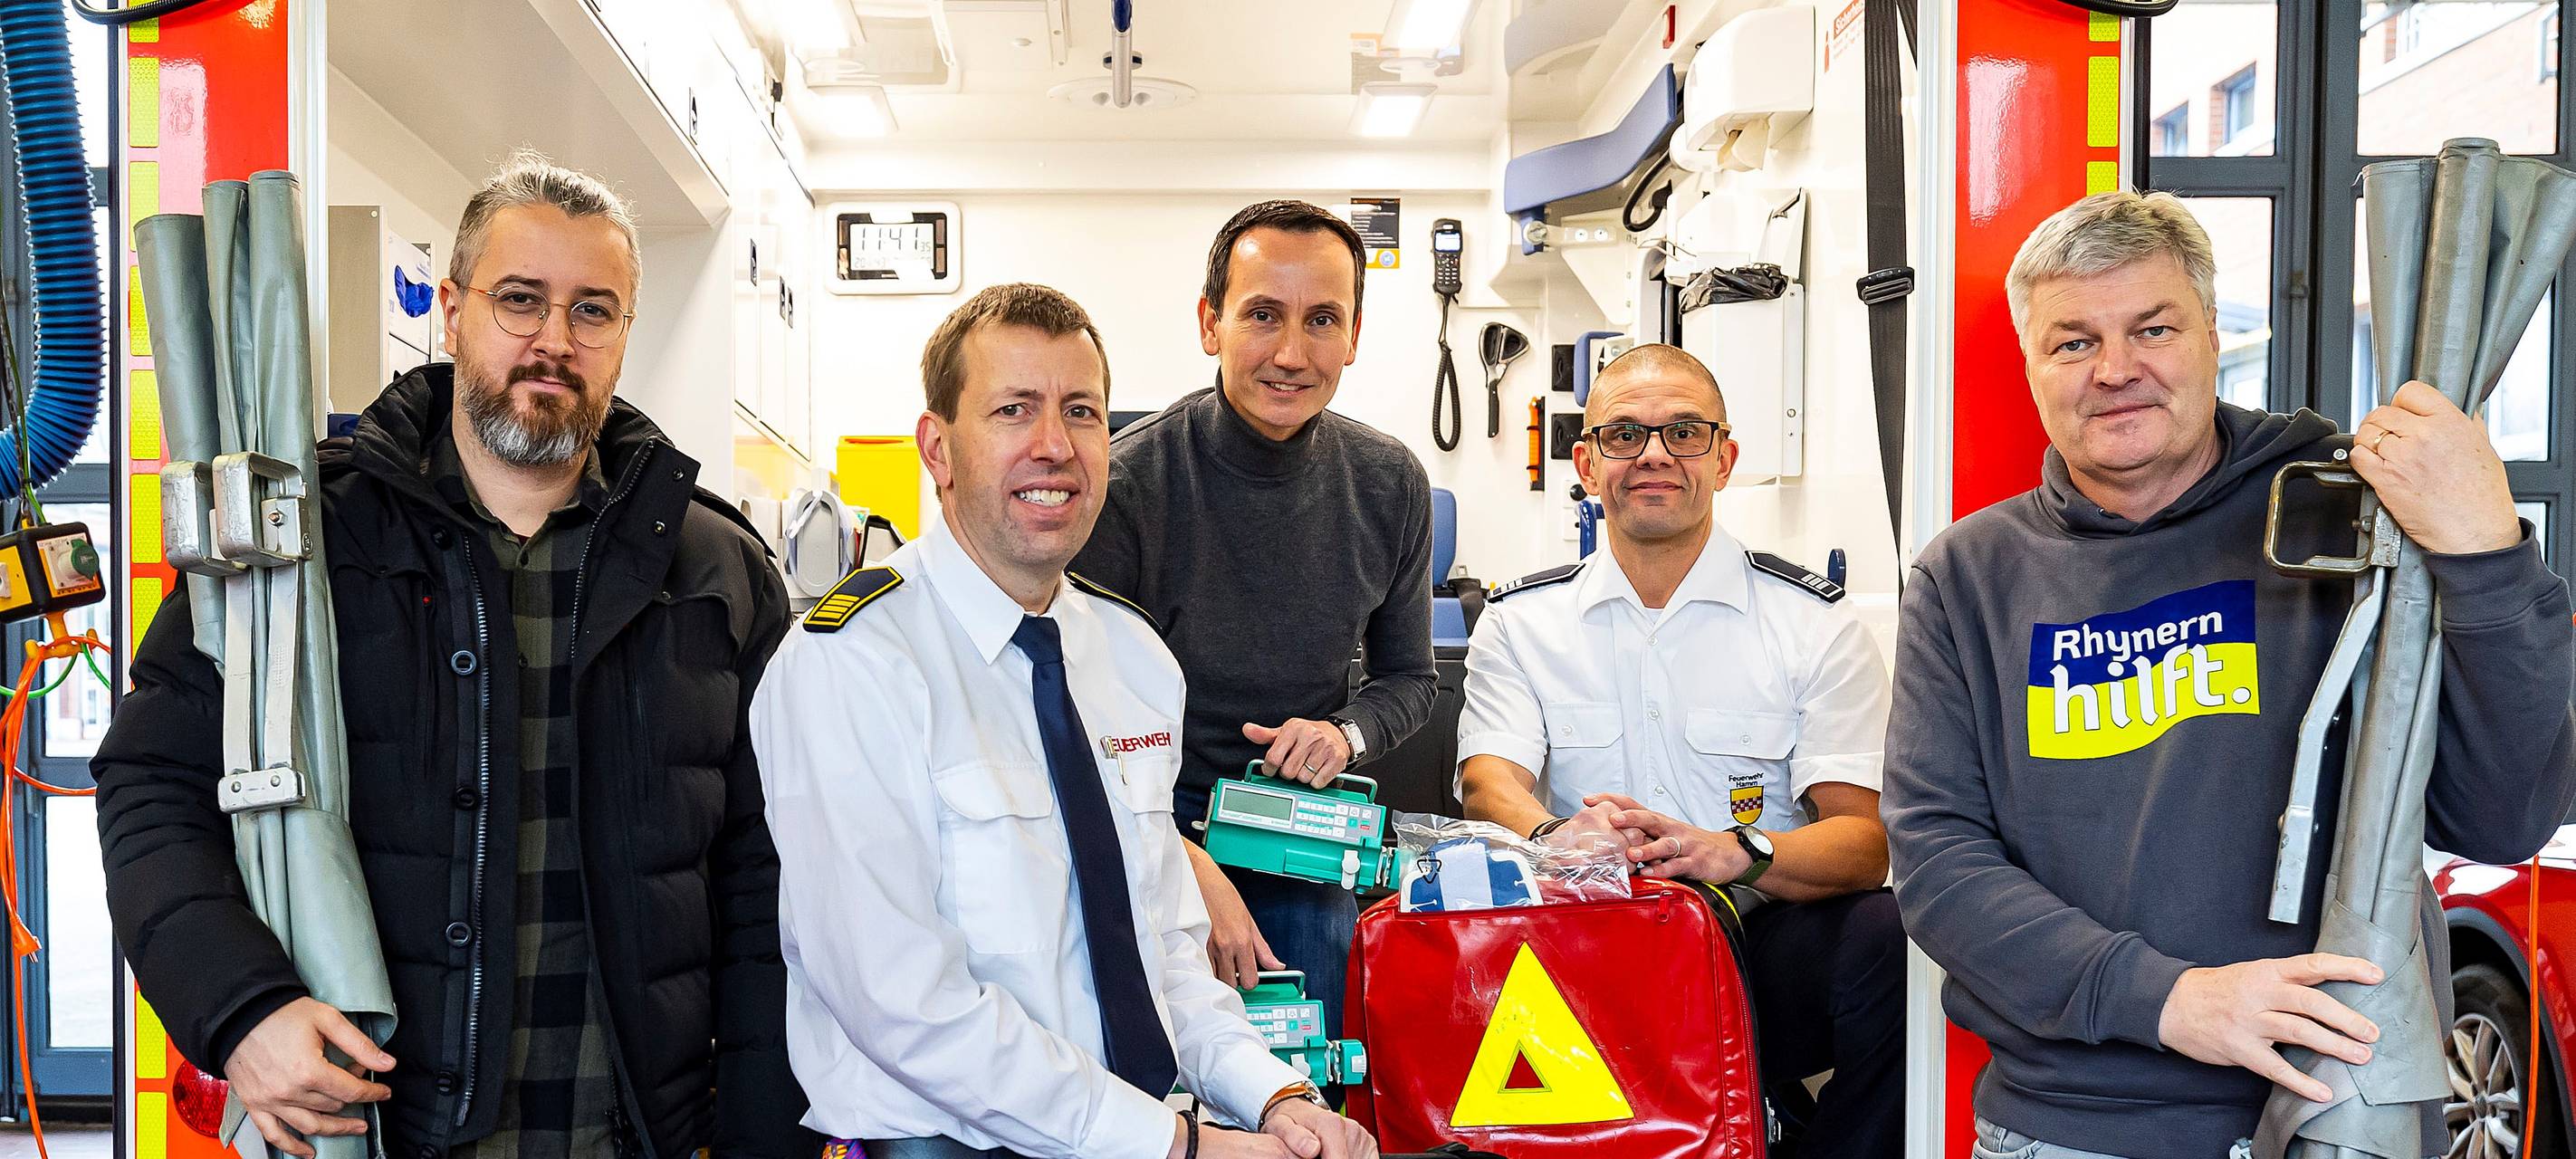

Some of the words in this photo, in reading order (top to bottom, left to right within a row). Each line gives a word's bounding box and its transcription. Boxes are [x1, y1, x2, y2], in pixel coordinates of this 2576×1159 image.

[2053, 611, 2223, 662] Rhynern
[2050, 644, 2251, 733] hilft.
[1100, 732, 1173, 752] EUERWEH
